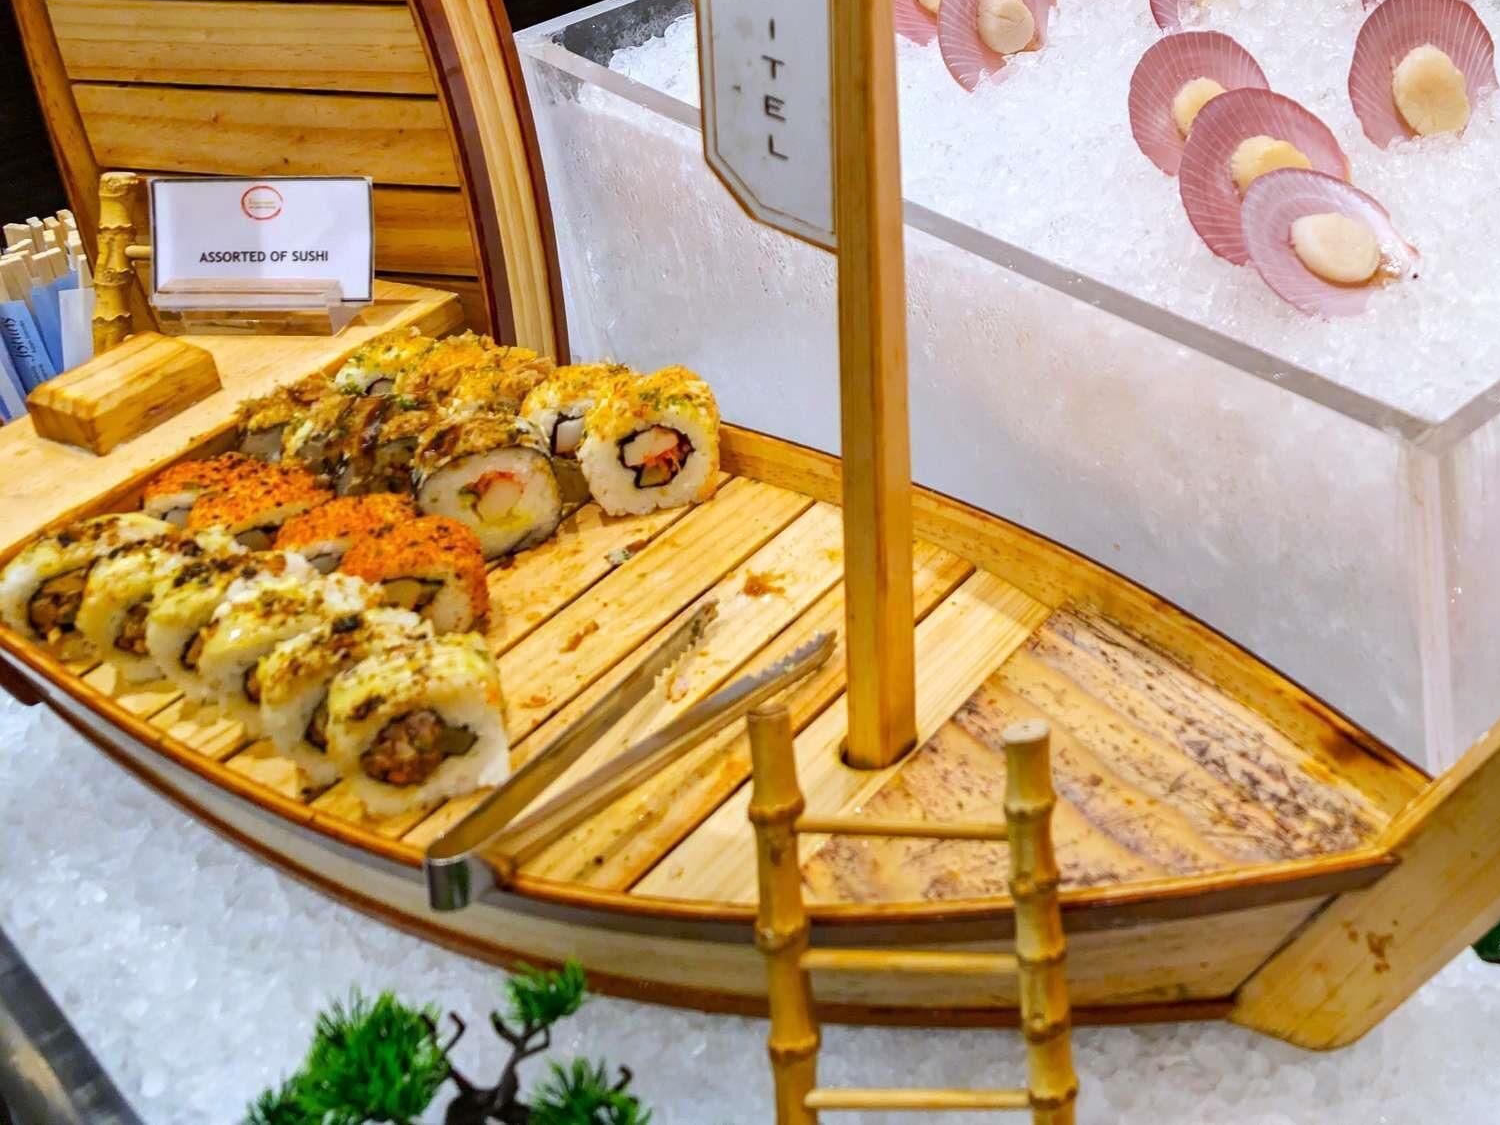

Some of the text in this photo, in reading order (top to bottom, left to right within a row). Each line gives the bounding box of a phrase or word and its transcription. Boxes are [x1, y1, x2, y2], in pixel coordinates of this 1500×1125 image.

[199, 250, 329, 263] ASSORTED OF SUSHI
